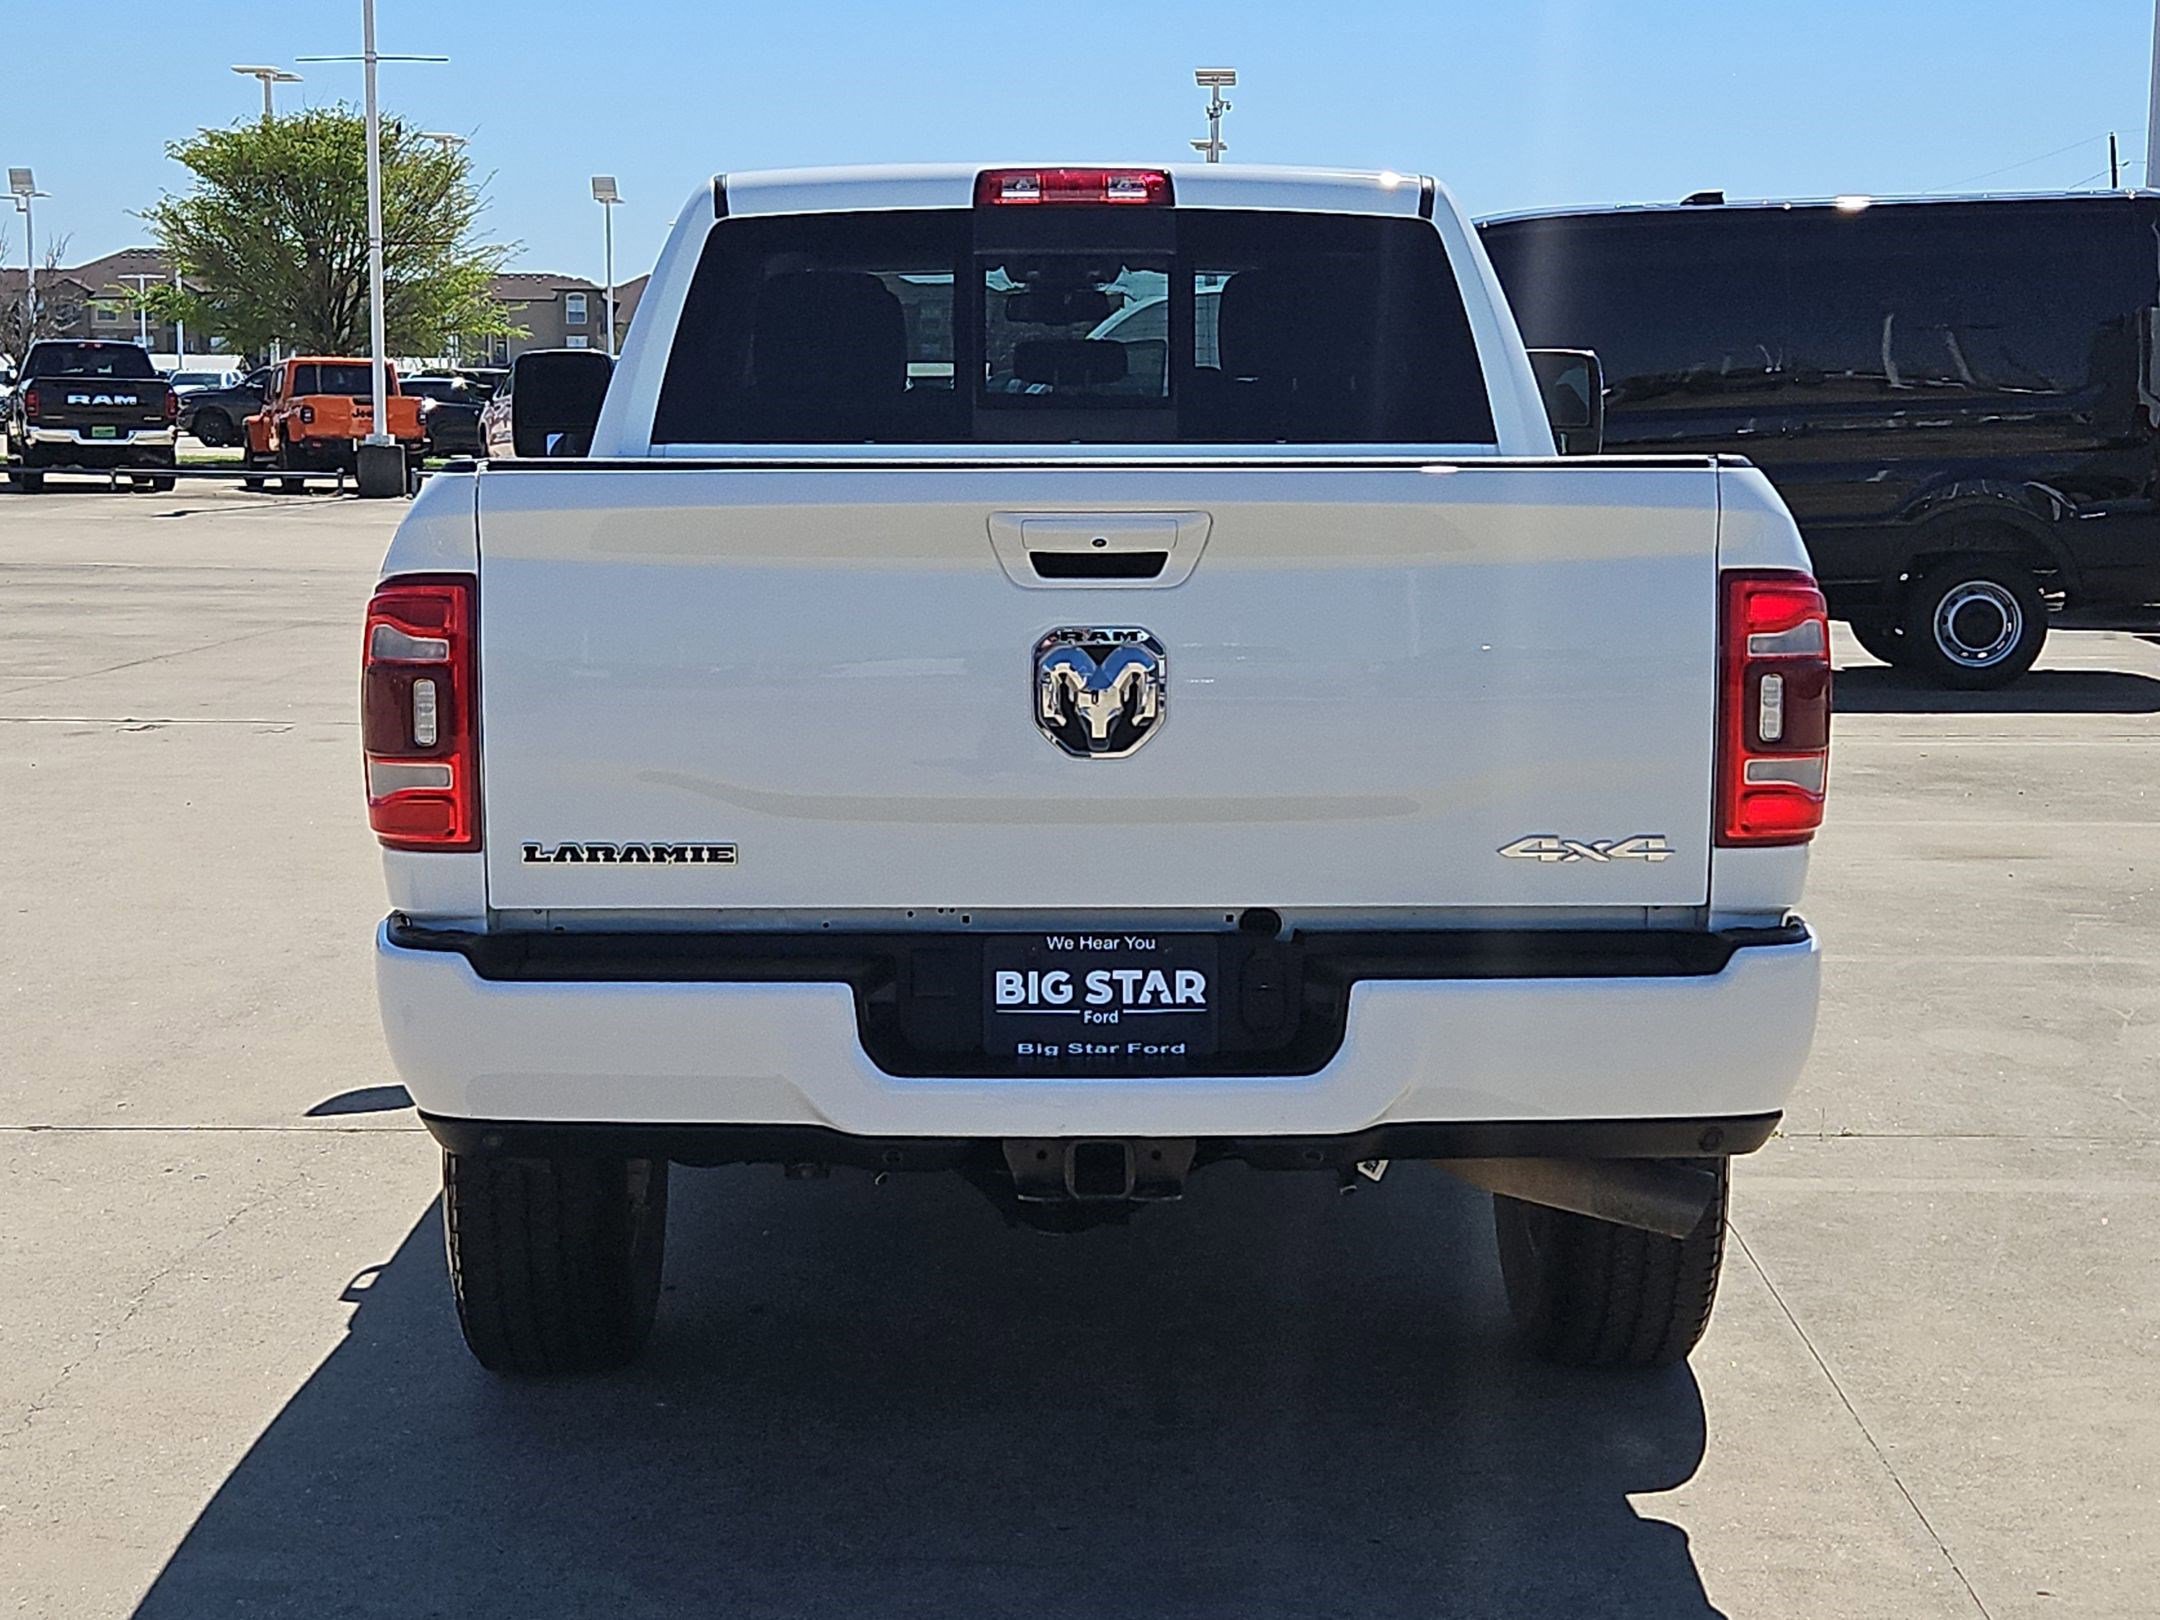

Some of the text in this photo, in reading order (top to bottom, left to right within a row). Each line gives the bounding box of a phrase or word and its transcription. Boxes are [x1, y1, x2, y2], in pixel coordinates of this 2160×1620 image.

[67, 394, 138, 405] RAM
[1060, 631, 1140, 642] RAM
[522, 843, 738, 864] LARAMIE
[1046, 936, 1156, 950] We Hear You
[996, 970, 1206, 1004] BIG STAR
[1083, 1010, 1119, 1024] Ford
[1017, 1043, 1186, 1056] Big Star Ford
